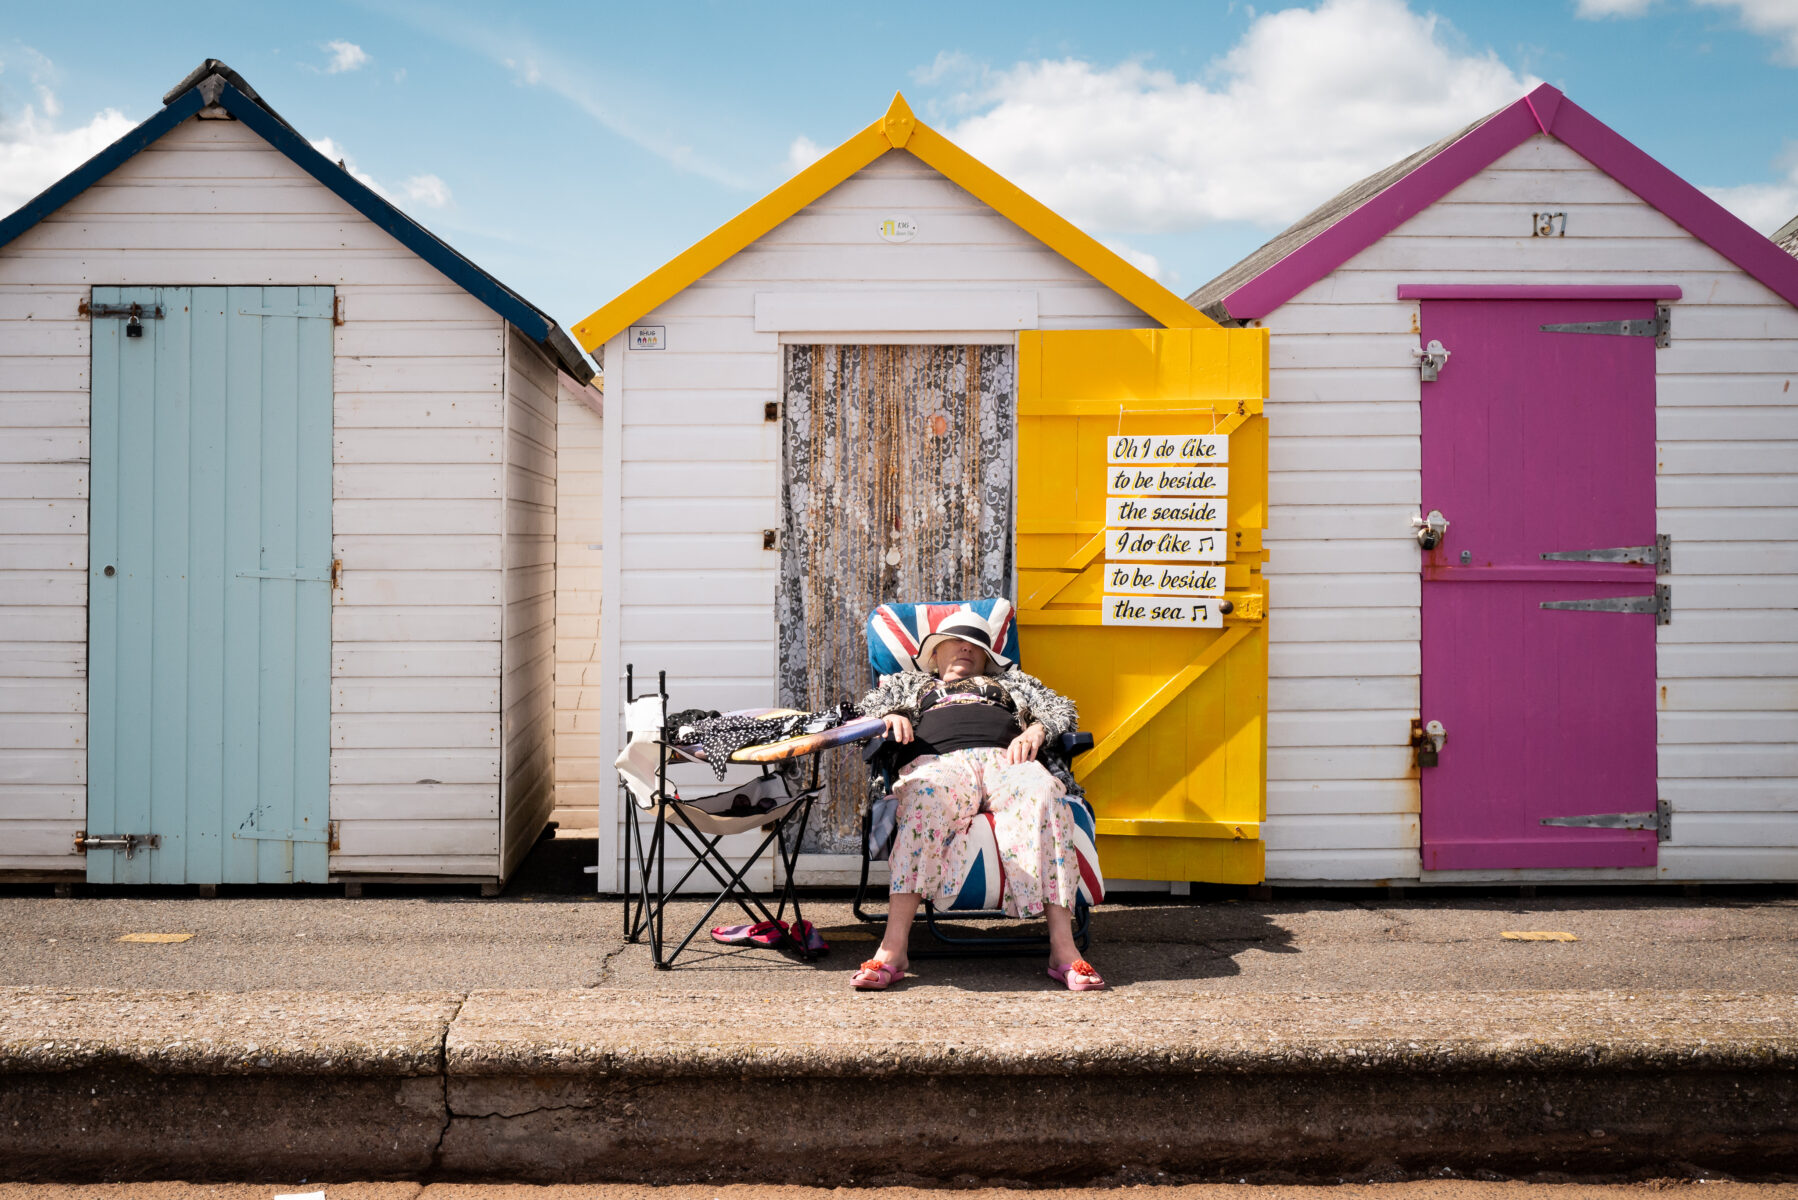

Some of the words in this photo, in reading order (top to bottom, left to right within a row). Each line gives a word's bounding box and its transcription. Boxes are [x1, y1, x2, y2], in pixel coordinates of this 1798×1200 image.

[1532, 212, 1568, 237] 137
[1113, 438, 1137, 458] Oh
[1142, 438, 1152, 458] I
[1154, 438, 1174, 458] do
[1180, 438, 1216, 458] like
[1113, 471, 1130, 489] to
[1132, 472, 1153, 489] be
[1157, 471, 1216, 489] beside
[1118, 501, 1147, 520] the
[1151, 502, 1216, 520] seaside
[1117, 532, 1129, 553] I
[1129, 534, 1156, 553] do
[1156, 534, 1191, 552] like
[1111, 568, 1129, 587] to
[1131, 568, 1154, 588] be
[1158, 569, 1216, 589] beside
[1113, 600, 1145, 618] the
[1150, 606, 1186, 620] sea
